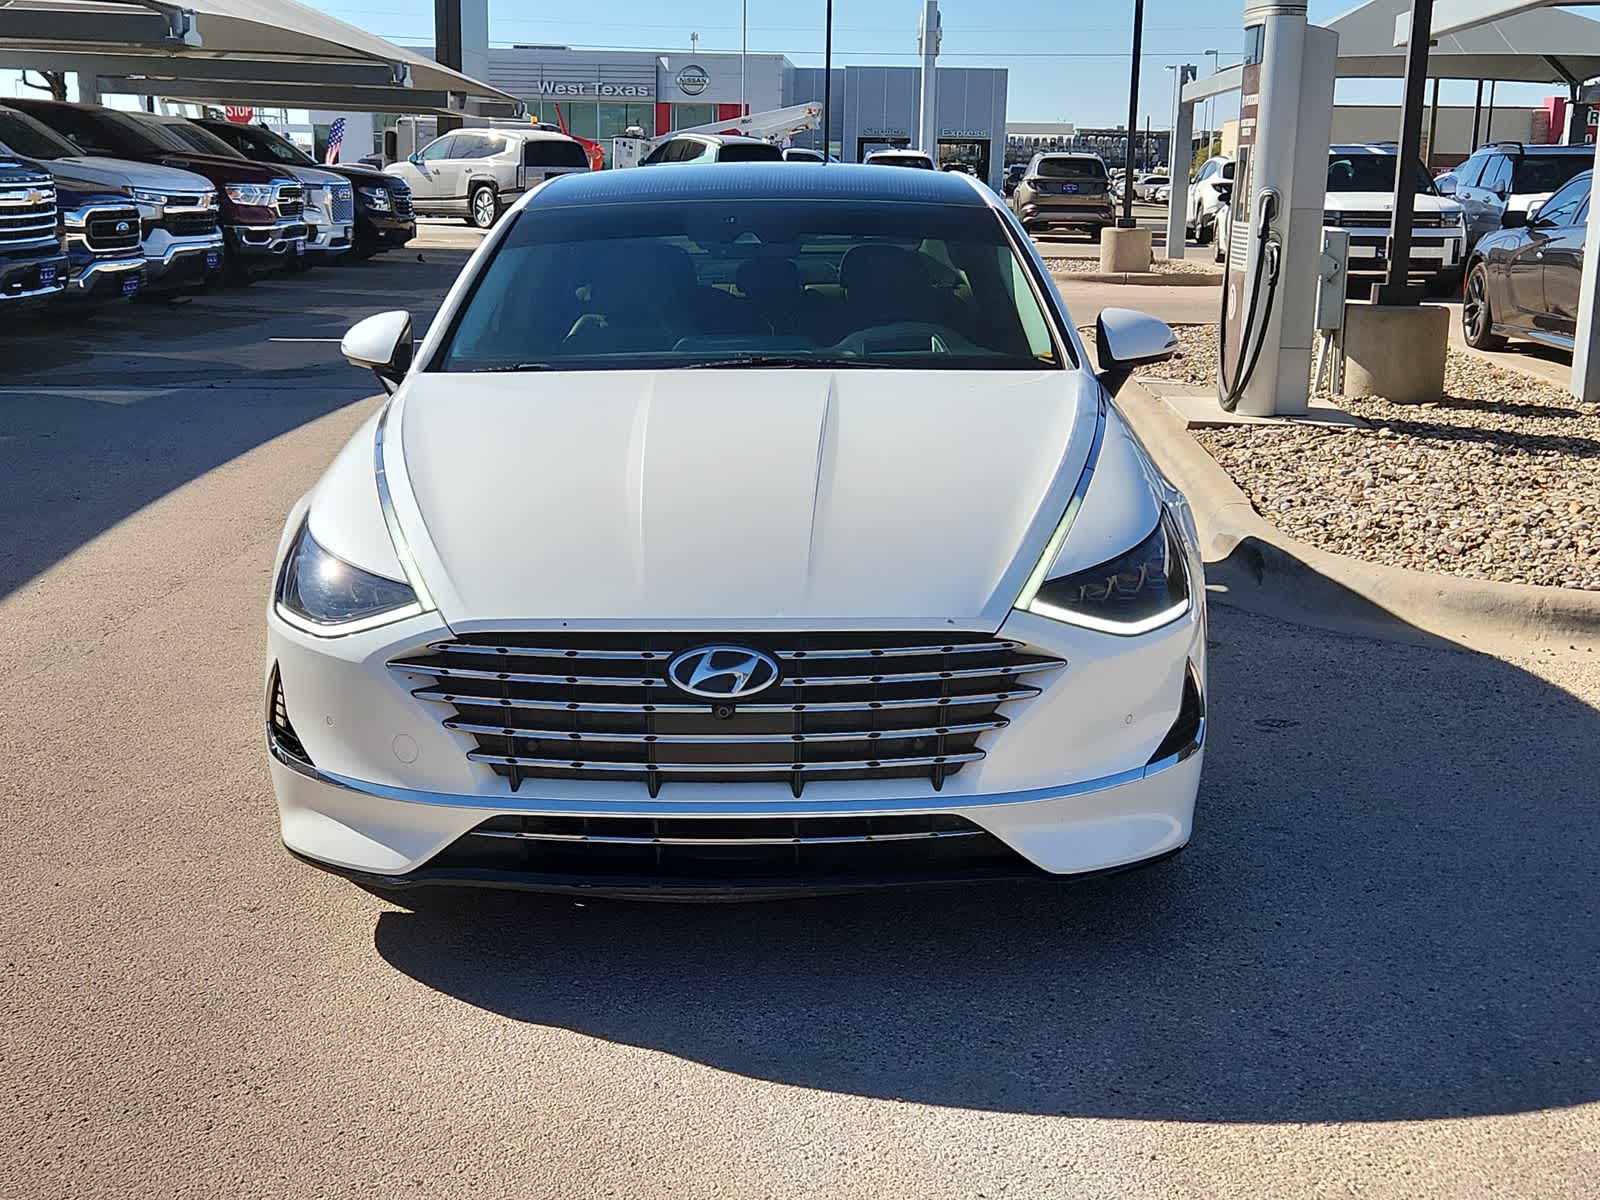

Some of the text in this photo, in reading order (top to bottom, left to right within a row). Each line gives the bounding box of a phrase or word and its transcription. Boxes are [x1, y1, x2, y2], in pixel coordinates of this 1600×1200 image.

[536, 80, 649, 97] West Texas
[226, 105, 252, 117] STOP
[941, 128, 987, 138] Express
